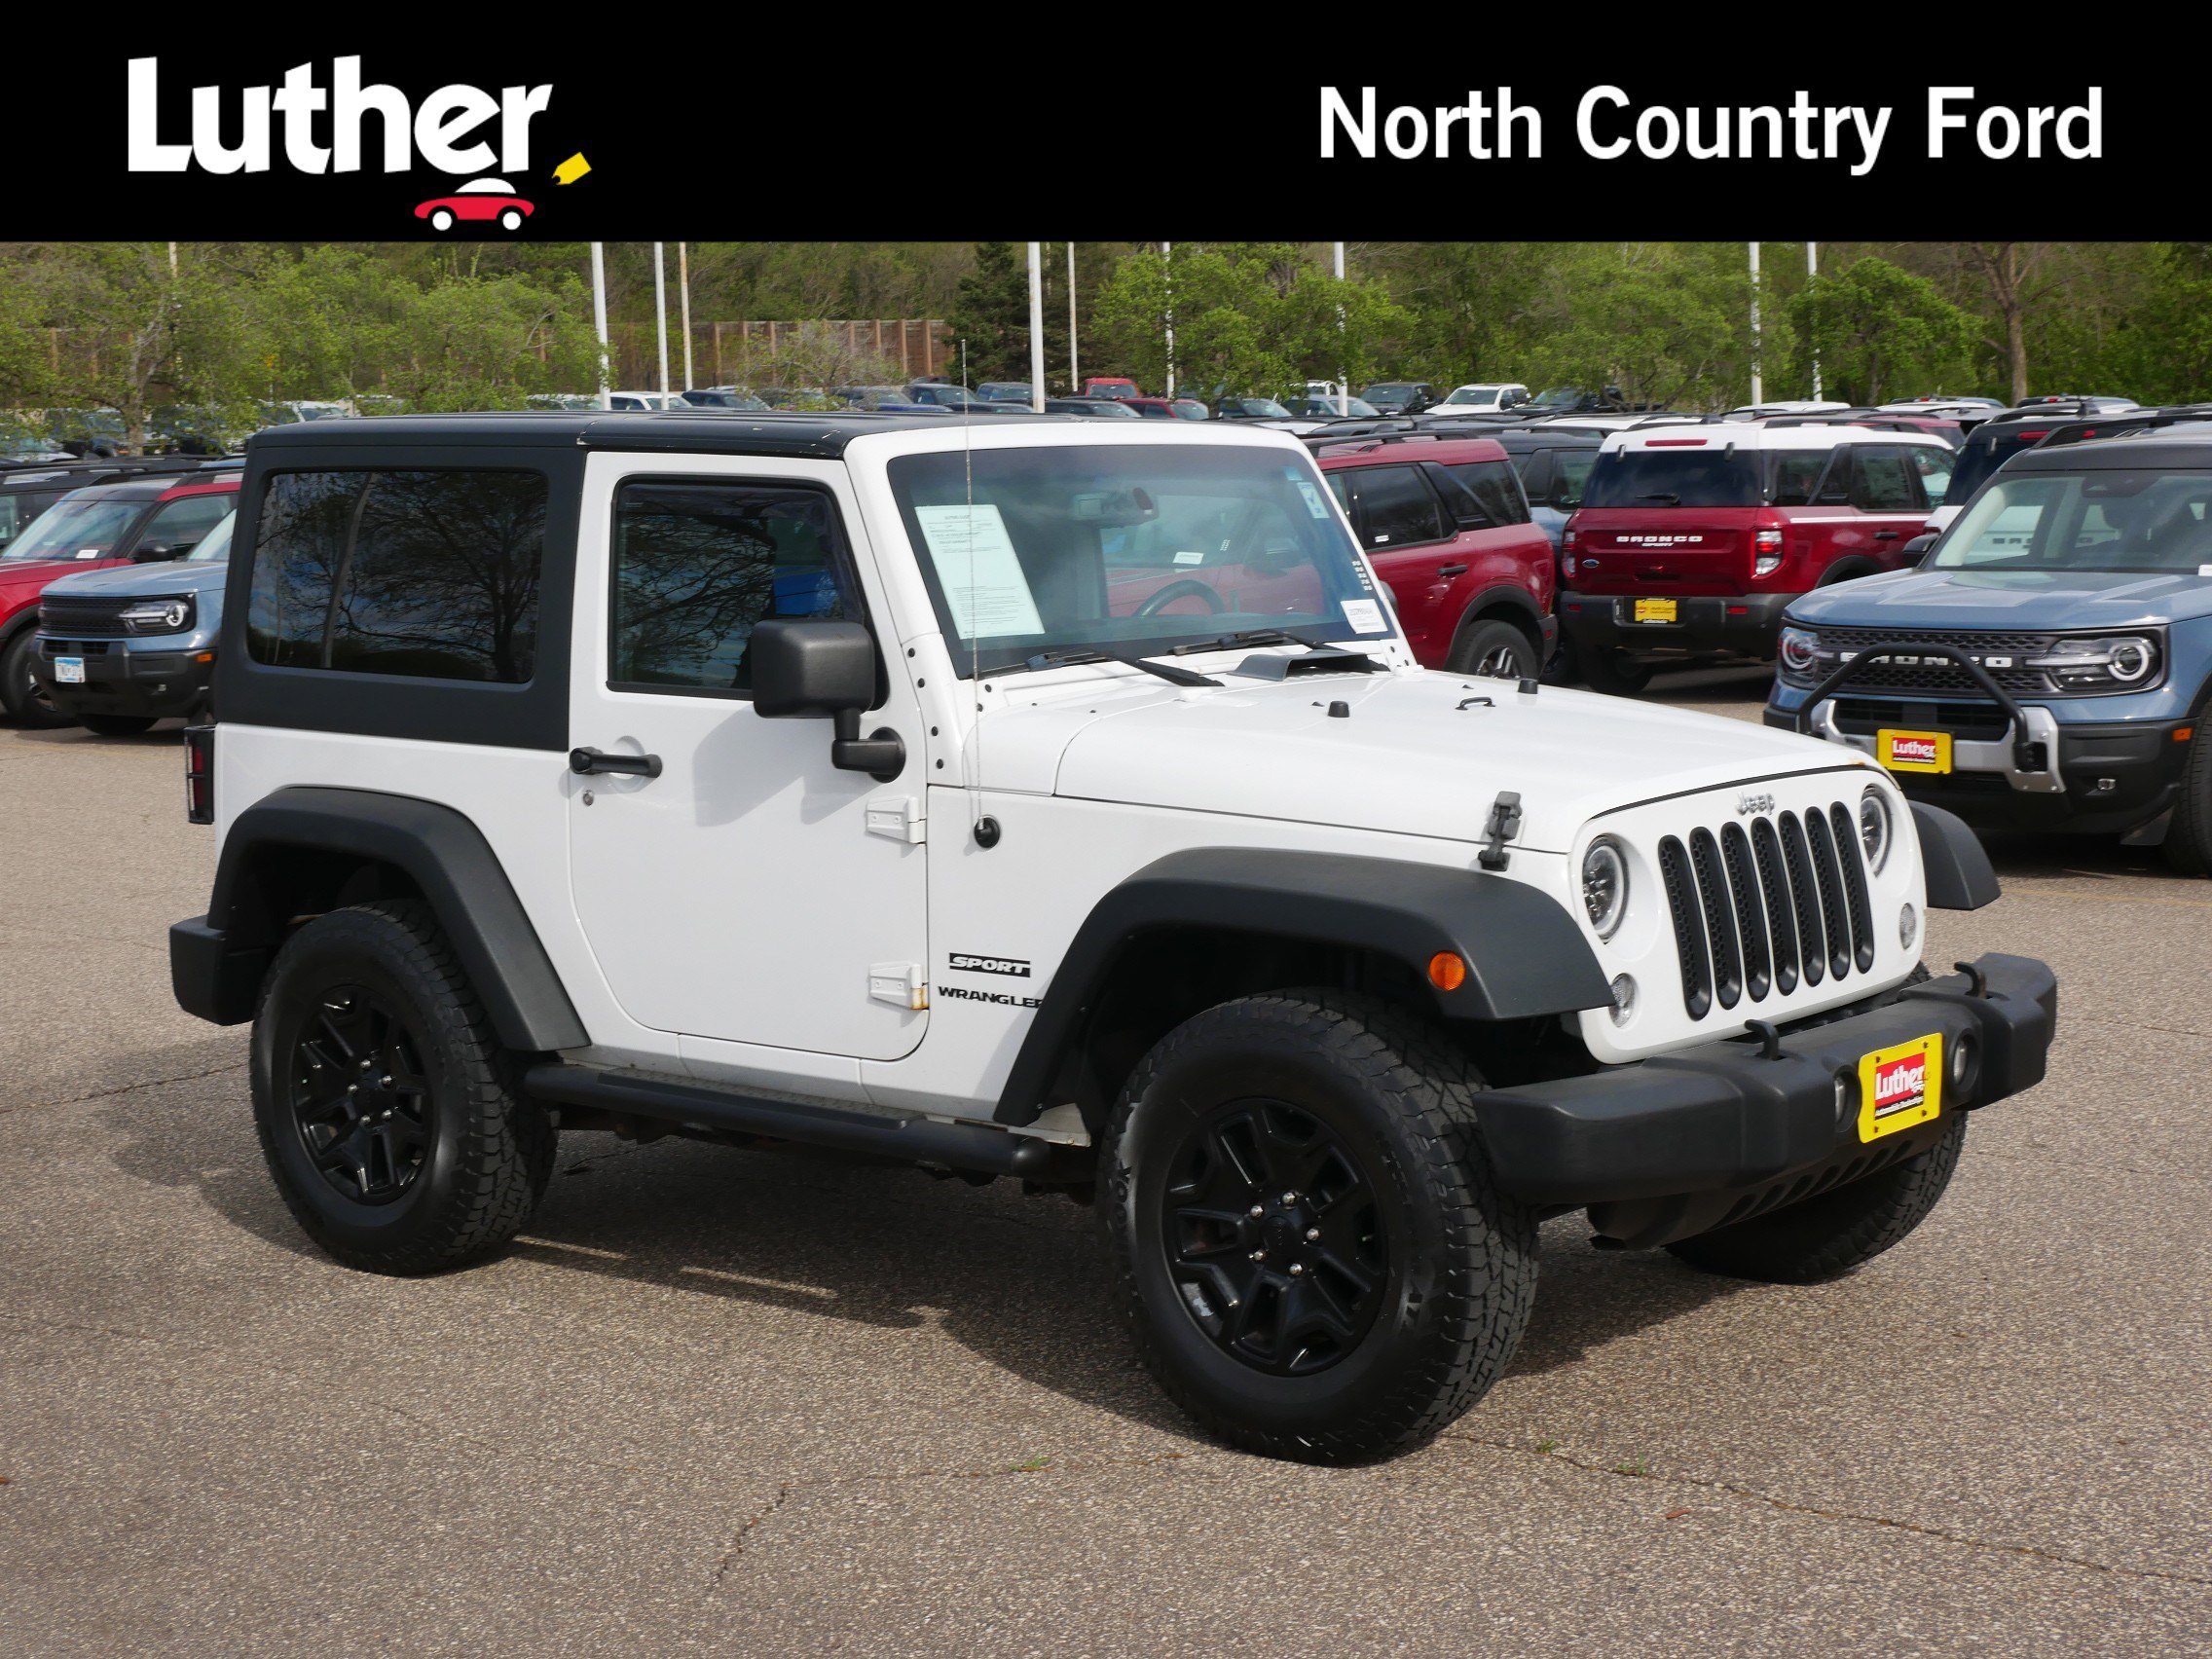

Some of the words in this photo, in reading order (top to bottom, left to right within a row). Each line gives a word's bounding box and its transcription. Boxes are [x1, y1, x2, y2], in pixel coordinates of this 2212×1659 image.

[1839, 651, 2012, 668] BRONO
[1892, 739, 1936, 755] Luther
[1736, 791, 1775, 816] Jeep
[950, 955, 1030, 975] SPORT
[1875, 1064, 1926, 1100] Luther
